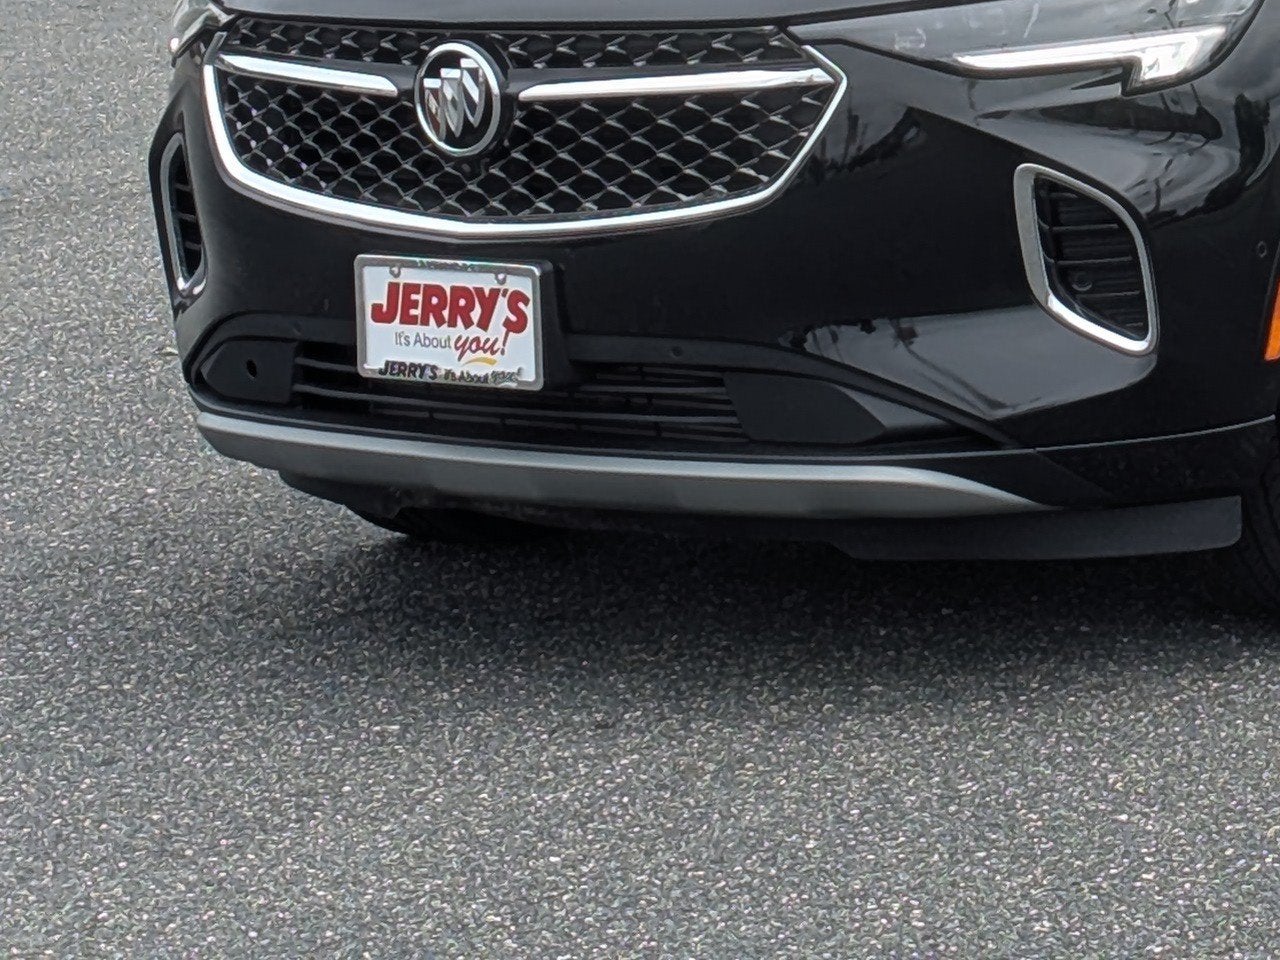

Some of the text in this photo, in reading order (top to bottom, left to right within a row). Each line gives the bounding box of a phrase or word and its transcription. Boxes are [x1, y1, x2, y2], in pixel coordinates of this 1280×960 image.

[371, 282, 530, 334] JERRY'S
[395, 331, 510, 361] It's About you!
[378, 360, 438, 380] JERRY'S
